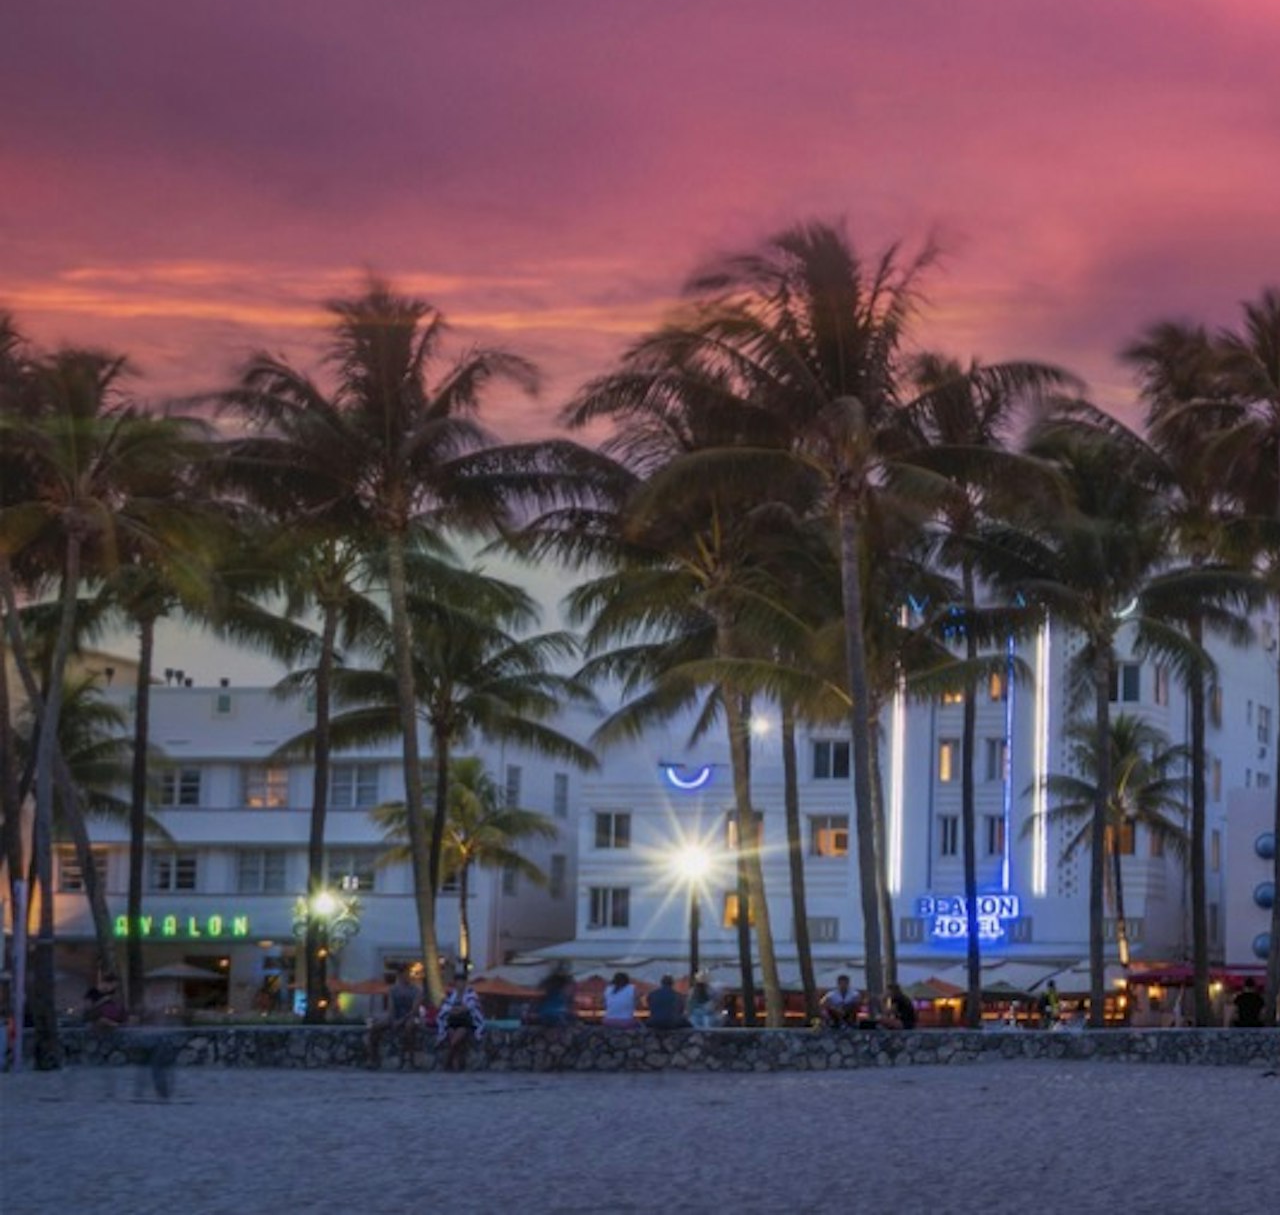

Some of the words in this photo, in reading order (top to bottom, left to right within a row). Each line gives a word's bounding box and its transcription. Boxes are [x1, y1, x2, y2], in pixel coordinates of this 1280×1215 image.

[918, 895, 1019, 918] BEAON
[113, 914, 249, 938] AVALON
[932, 916, 1004, 938] HOEL
